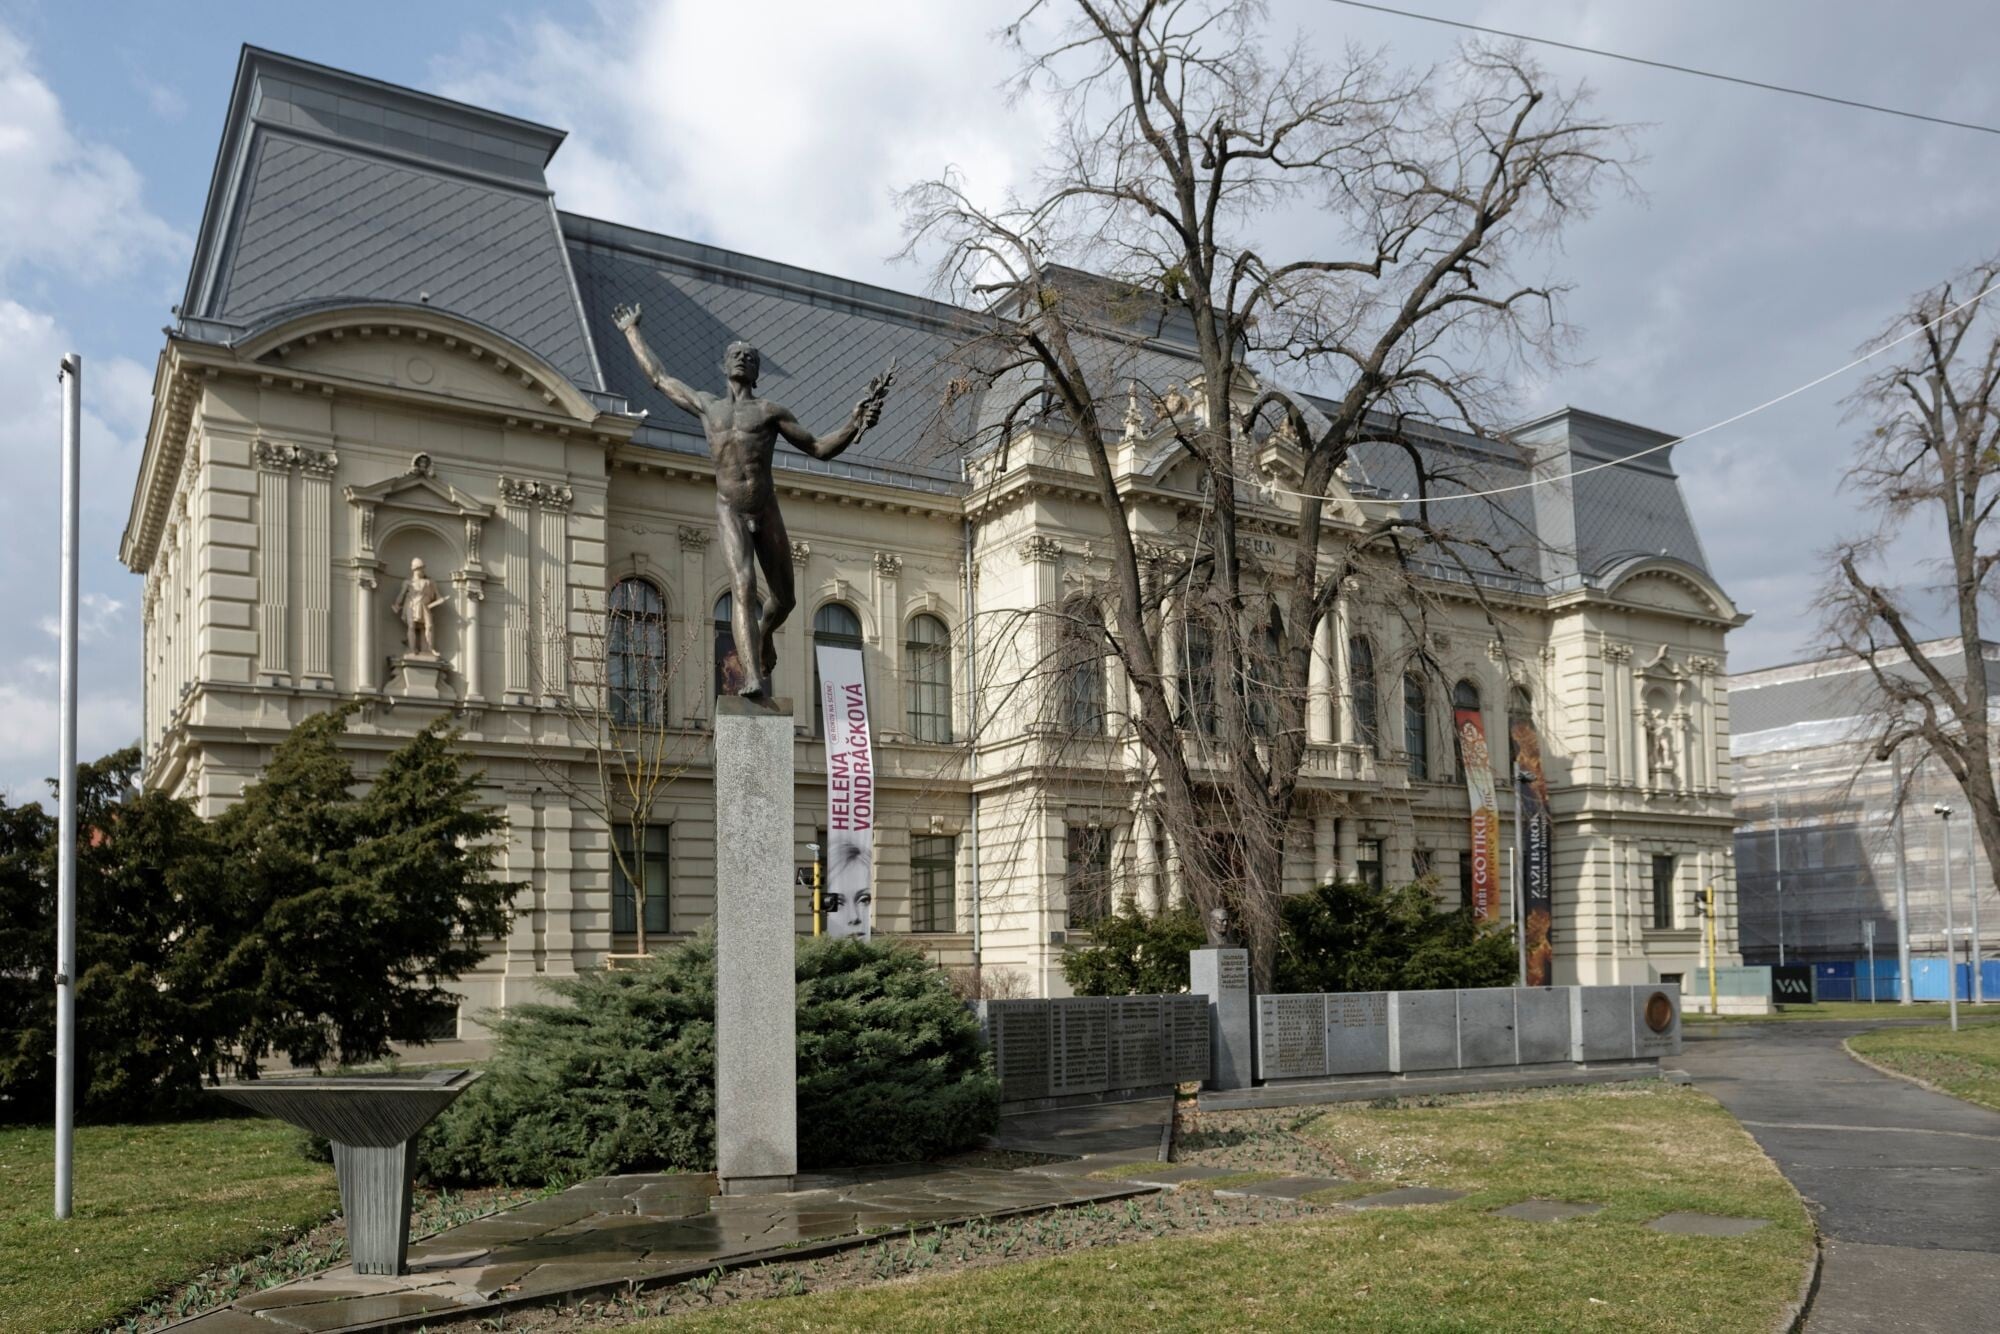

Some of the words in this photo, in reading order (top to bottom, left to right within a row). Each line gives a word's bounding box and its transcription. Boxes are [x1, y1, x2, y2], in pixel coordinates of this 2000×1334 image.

[828, 704, 834, 712] NA
[831, 752, 850, 830] HELENA
[841, 683, 871, 832] VONDRÁČKOVÁ
[1474, 815, 1487, 885] GOTIKU
[1530, 812, 1540, 862] BAROK
